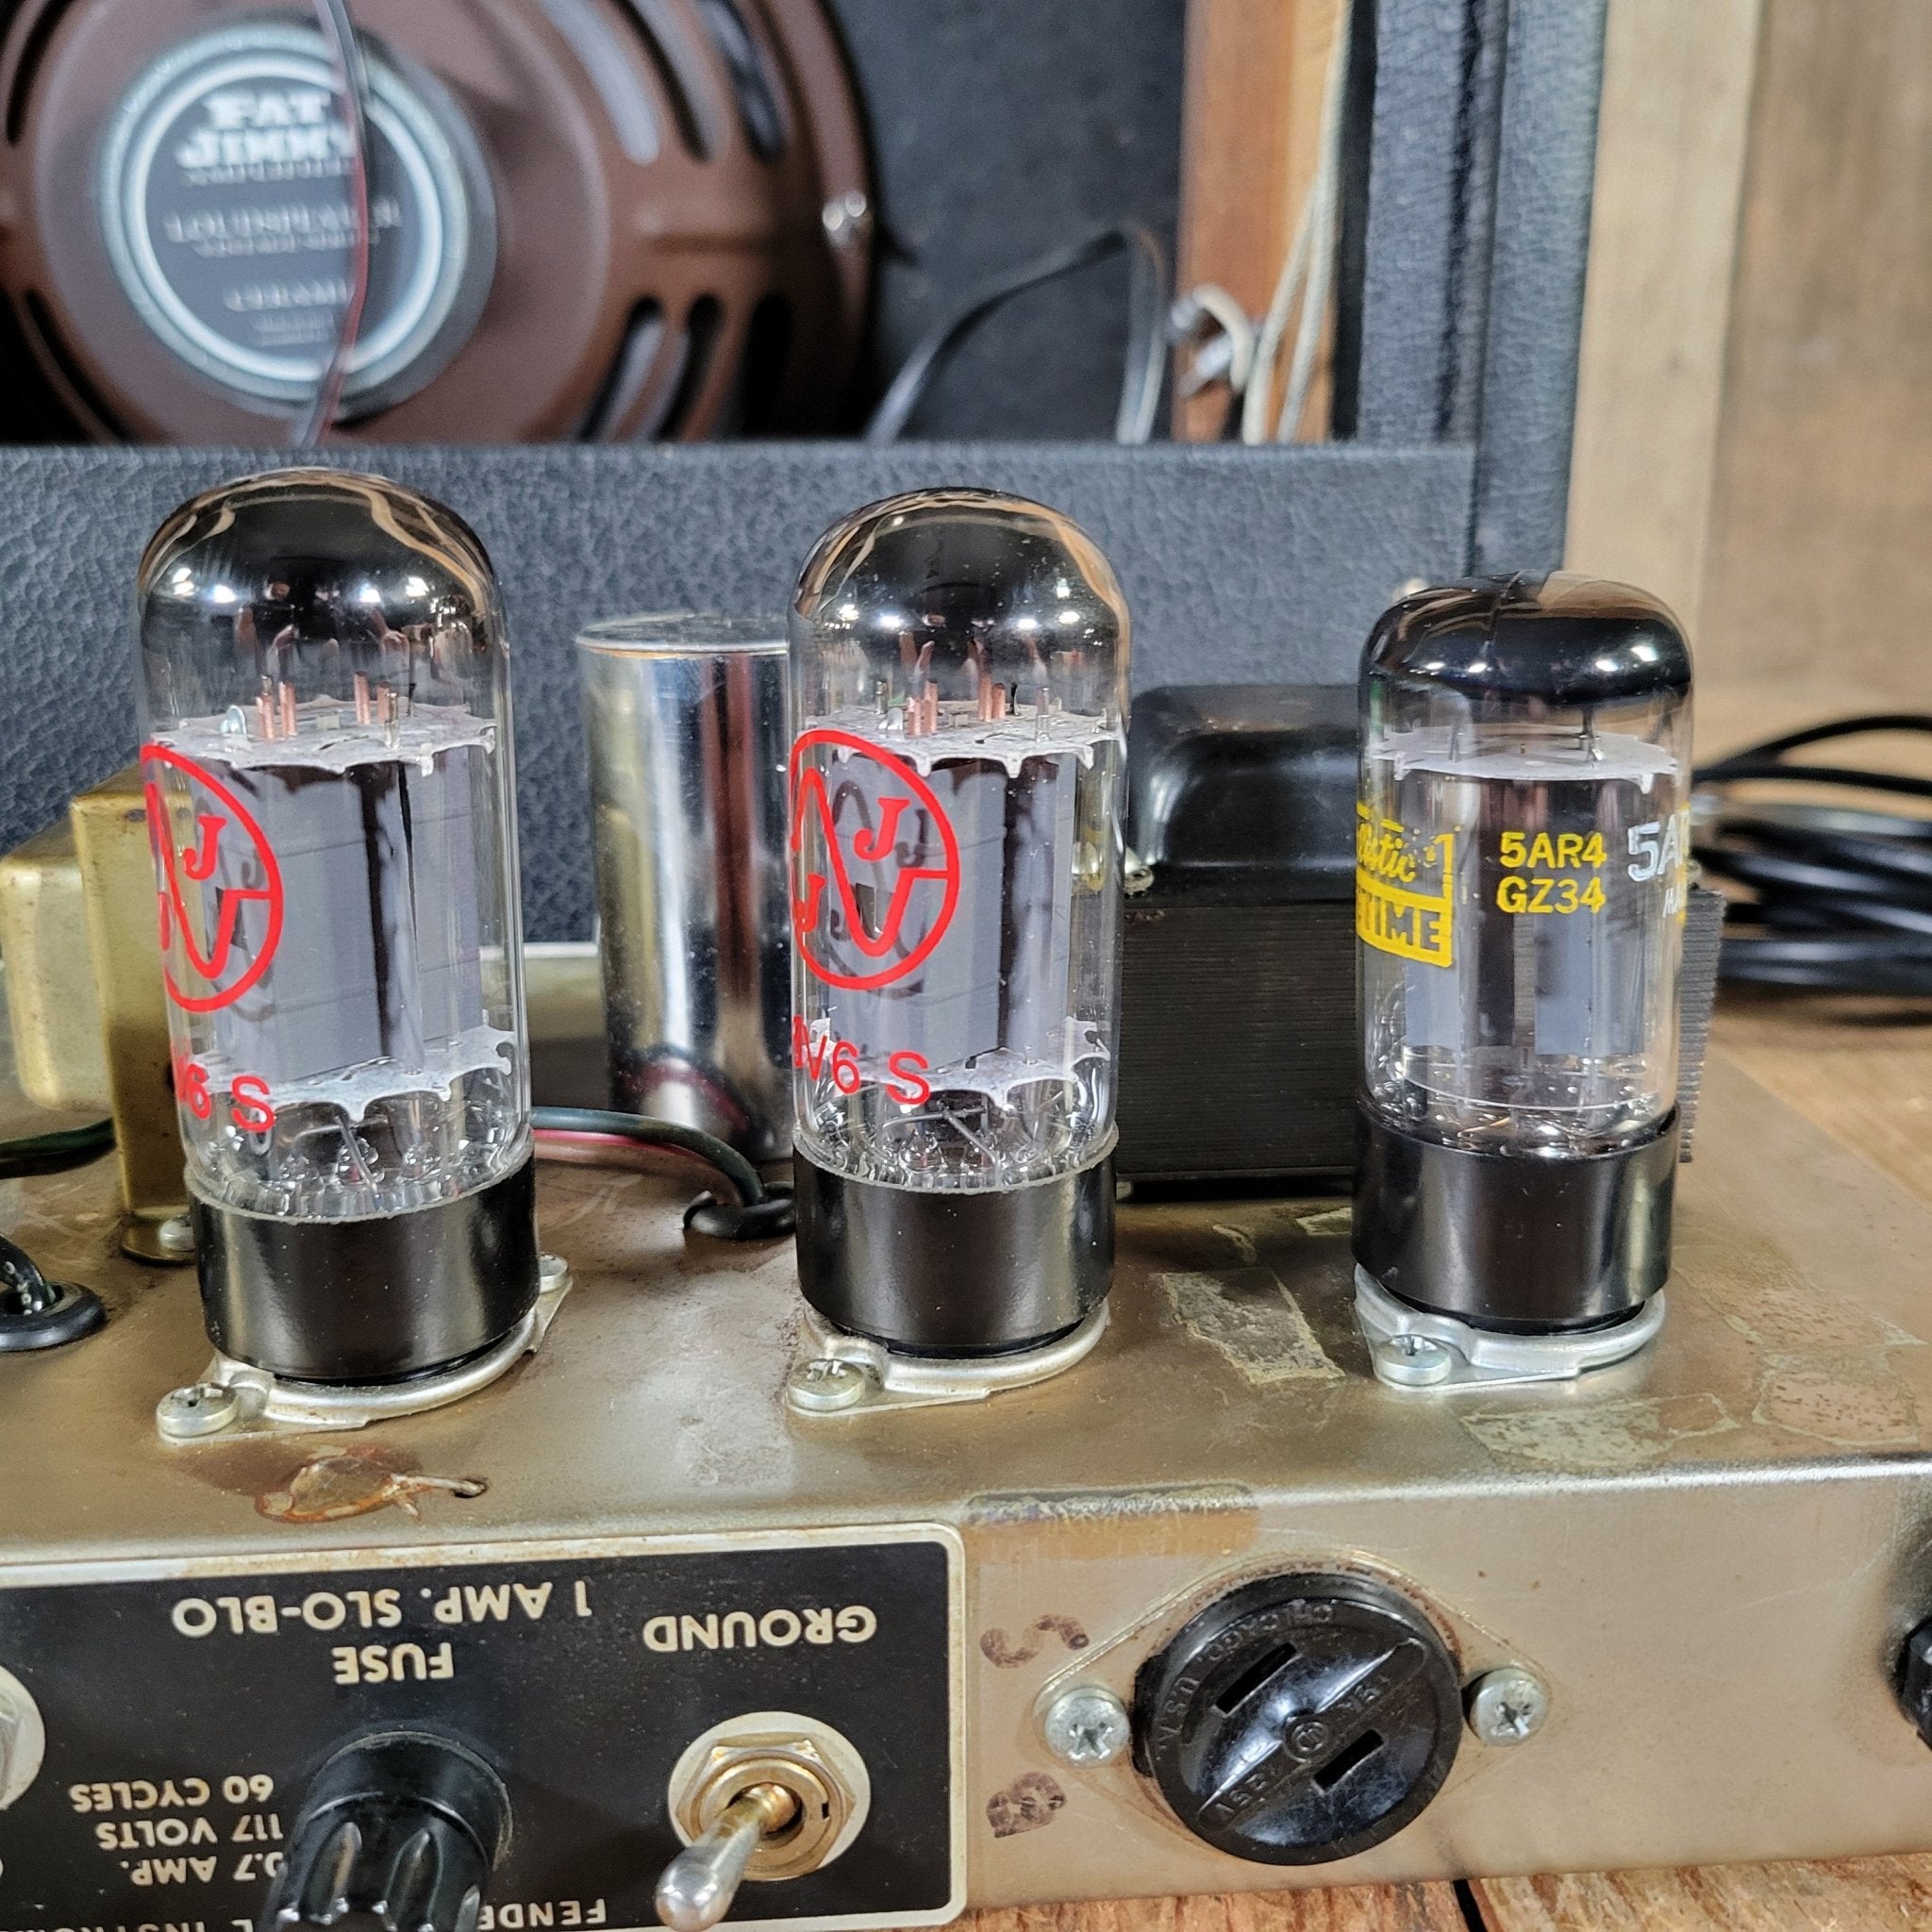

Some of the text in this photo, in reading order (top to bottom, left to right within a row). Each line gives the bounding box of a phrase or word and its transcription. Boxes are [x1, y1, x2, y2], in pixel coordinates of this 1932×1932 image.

[204, 92, 331, 130] FAT
[1500, 831, 1607, 870] 5AR4
[1497, 875, 1607, 915] GZ34
[886, 1049, 931, 1106] S
[231, 1074, 276, 1133] S
[171, 1580, 592, 1638] 1 AMP. SLO-BLO
[642, 1605, 877, 1653] GROUND
[330, 1641, 455, 1685] FUSE
[68, 1774, 275, 1813] 60 CYCLES
[95, 1812, 284, 1851] 117 VOLTS
[120, 1851, 285, 1887] 0.7 AMP.
[477, 1897, 607, 1931] FENDE
